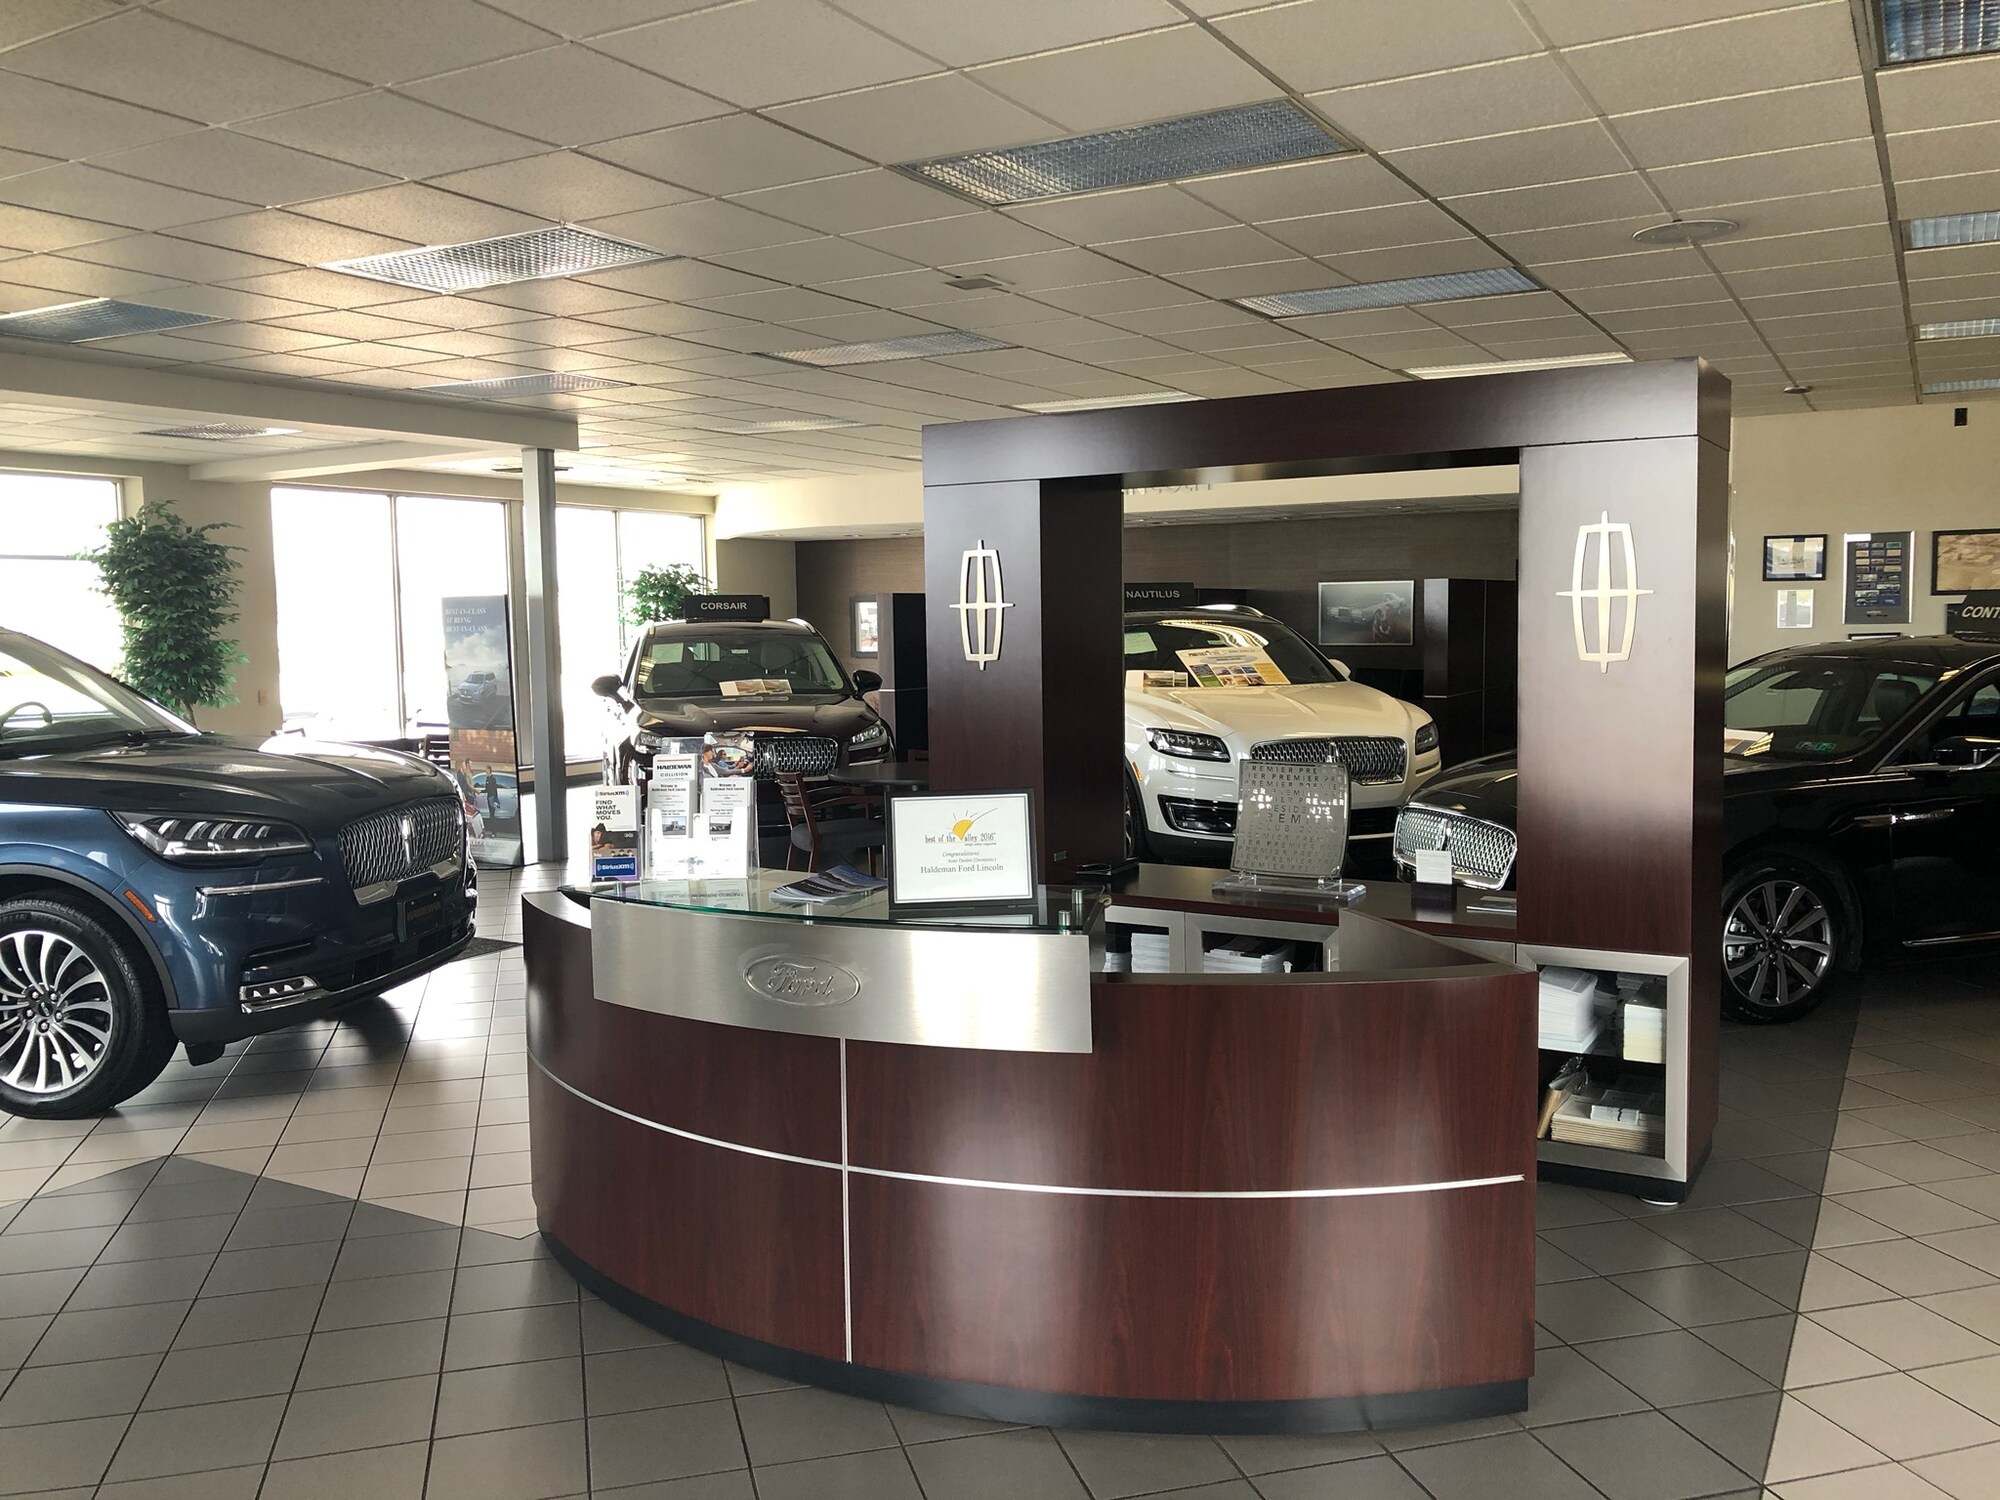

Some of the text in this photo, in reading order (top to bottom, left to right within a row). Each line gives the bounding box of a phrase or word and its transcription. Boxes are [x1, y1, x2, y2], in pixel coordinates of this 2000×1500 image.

[1126, 590, 1180, 599] NAUTILUS
[700, 602, 747, 610] CORSAIR
[1961, 605, 2000, 619] CONT
[1272, 773, 1321, 782] PREMIER
[924, 835, 936, 844] best
[938, 834, 944, 842] of
[946, 833, 956, 842] the
[920, 865, 956, 874] Haldeman
[767, 960, 835, 998] Ford
